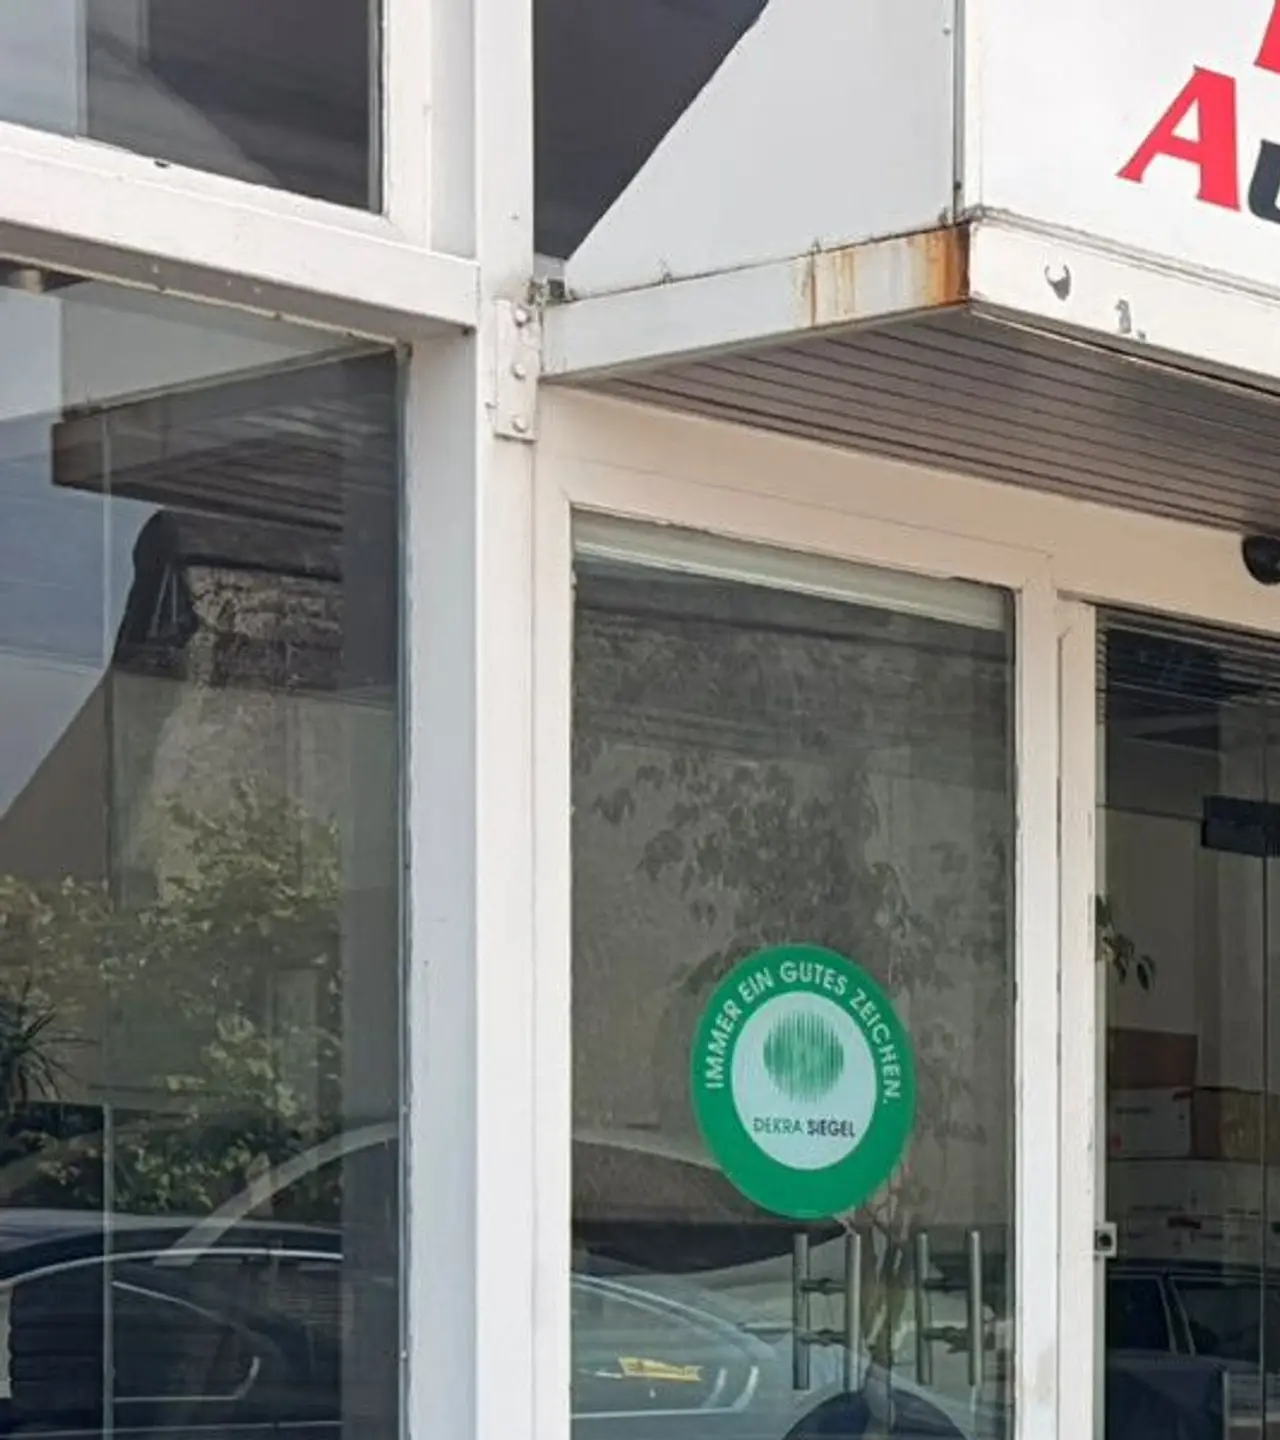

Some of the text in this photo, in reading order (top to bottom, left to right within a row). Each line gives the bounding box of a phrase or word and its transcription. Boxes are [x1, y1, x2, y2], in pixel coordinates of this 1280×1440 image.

[704, 998, 743, 1090] IMMER
[738, 966, 775, 1005] EIN
[779, 960, 849, 997] GUTES
[752, 1115, 857, 1139] DEKRA SIEGEL
